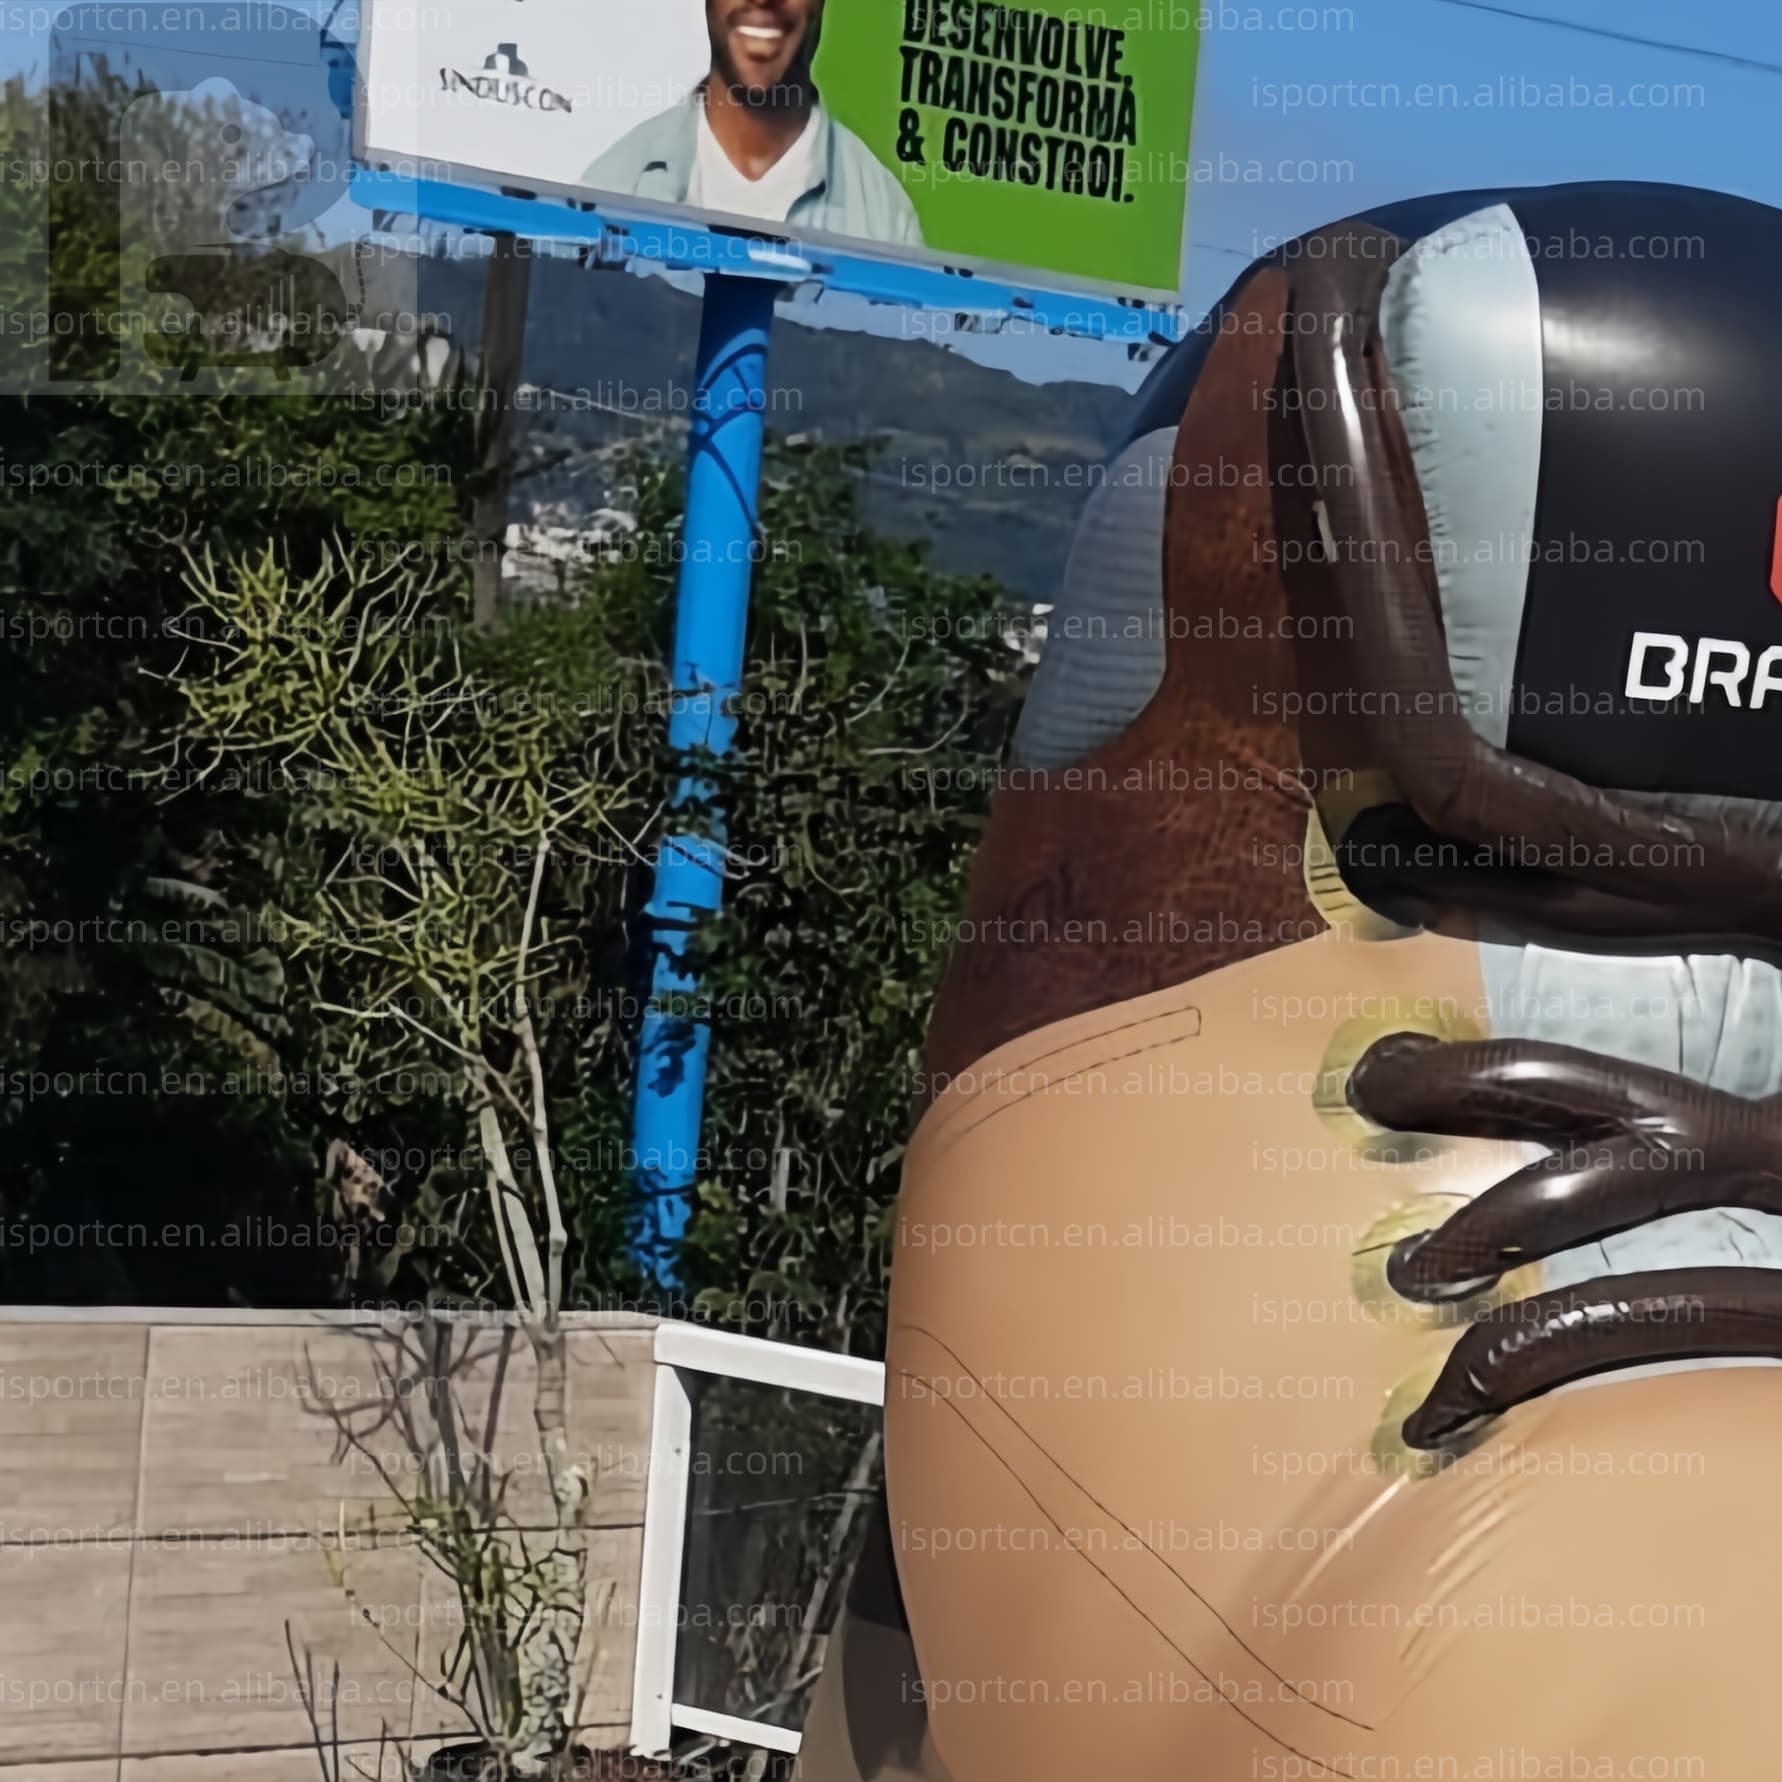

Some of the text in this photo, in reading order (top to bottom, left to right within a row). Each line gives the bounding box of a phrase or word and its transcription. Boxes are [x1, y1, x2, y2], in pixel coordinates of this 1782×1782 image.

[902, 0, 1134, 88] DESENVOLVE,
[899, 45, 1137, 146] TRANSFORMA
[896, 107, 1134, 203] & CONSTROI.
